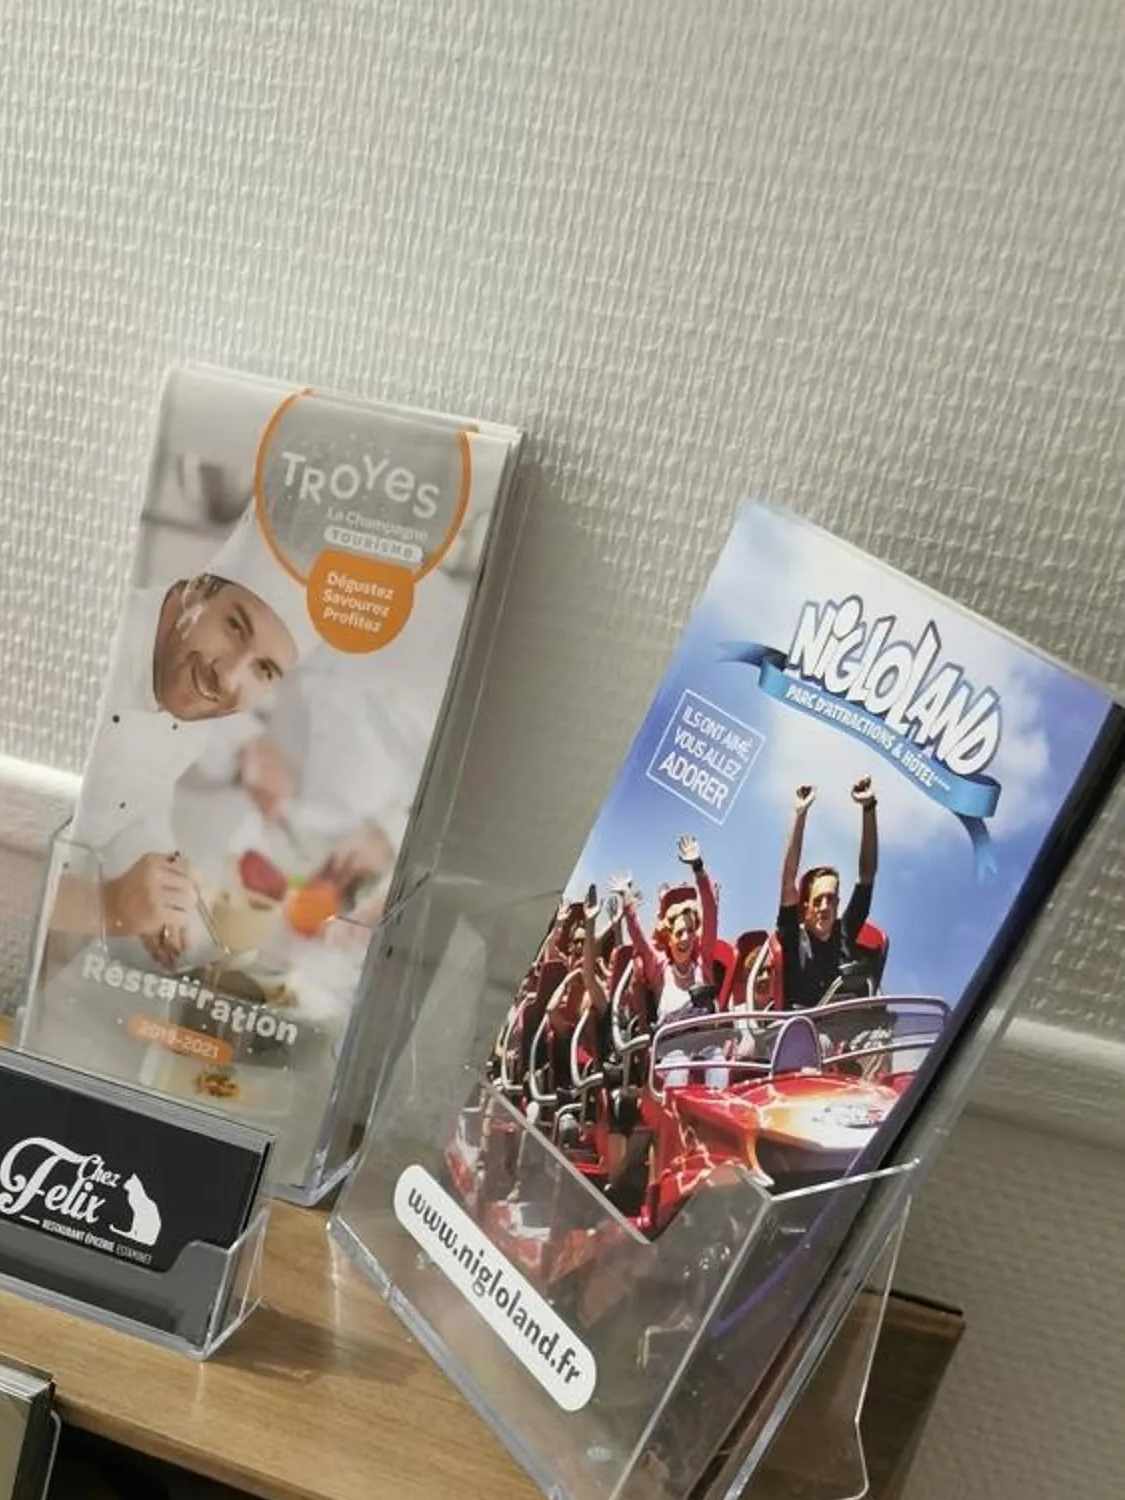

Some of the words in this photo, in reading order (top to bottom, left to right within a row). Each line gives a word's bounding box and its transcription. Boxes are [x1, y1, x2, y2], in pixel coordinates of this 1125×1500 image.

[331, 528, 416, 559] TOURISME
[345, 511, 428, 542] Champagne
[327, 571, 395, 601] Dégustez
[322, 589, 390, 618] Savourez
[322, 605, 382, 633] Profitez
[682, 706, 704, 728] ILS
[700, 717, 728, 741] ONT
[785, 684, 815, 709] PARC
[814, 697, 896, 750] D'ATTRACTIONS
[891, 742, 902, 759] &
[674, 726, 707, 758] VOUS
[701, 747, 742, 781] ALLEZ
[658, 751, 729, 809] ADORER
[78, 1154, 122, 1188] Chez
[408, 1187, 581, 1384] www.nigloland.fr
